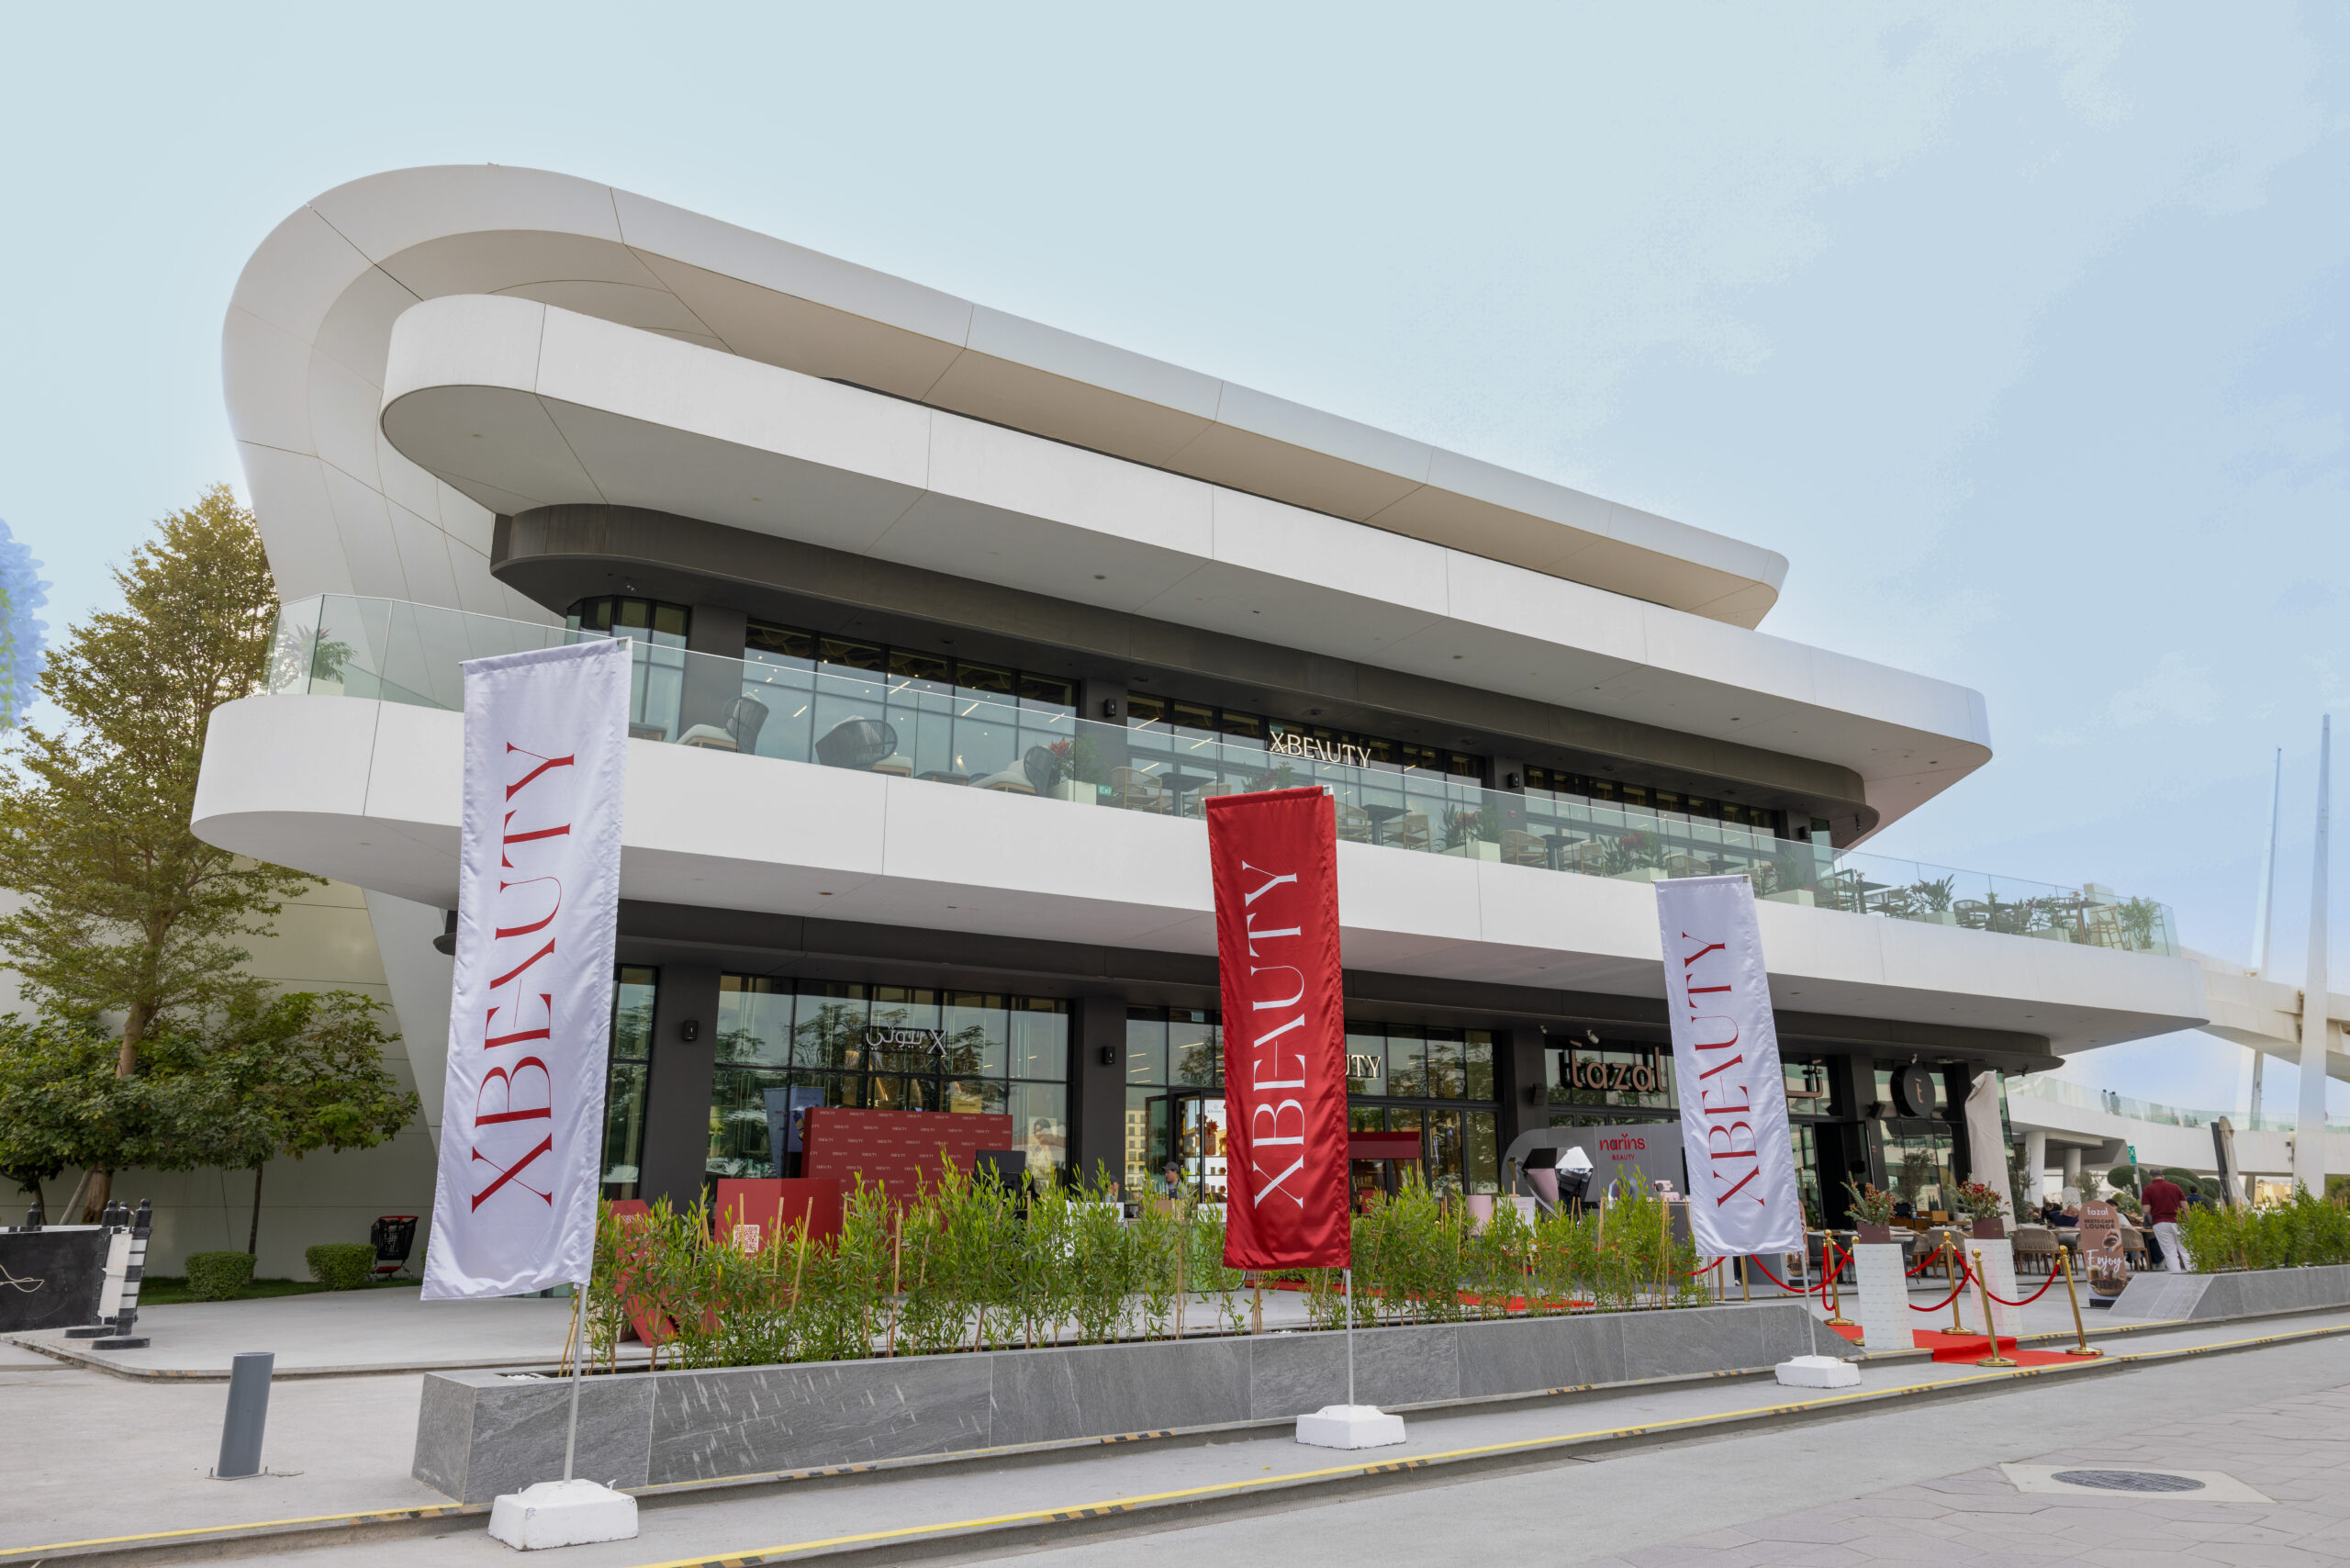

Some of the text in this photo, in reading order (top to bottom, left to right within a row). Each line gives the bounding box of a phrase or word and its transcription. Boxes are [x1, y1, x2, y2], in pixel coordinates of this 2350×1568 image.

[1270, 731, 1371, 768] XBEAUTY
[472, 741, 575, 1214] XBEAUTY
[1242, 860, 1305, 1210] XBEAUTY
[1570, 1039, 1667, 1092] tazal
[1682, 931, 1765, 1208] XBEAUTY
[2086, 1249, 2121, 1273] Enjoy
